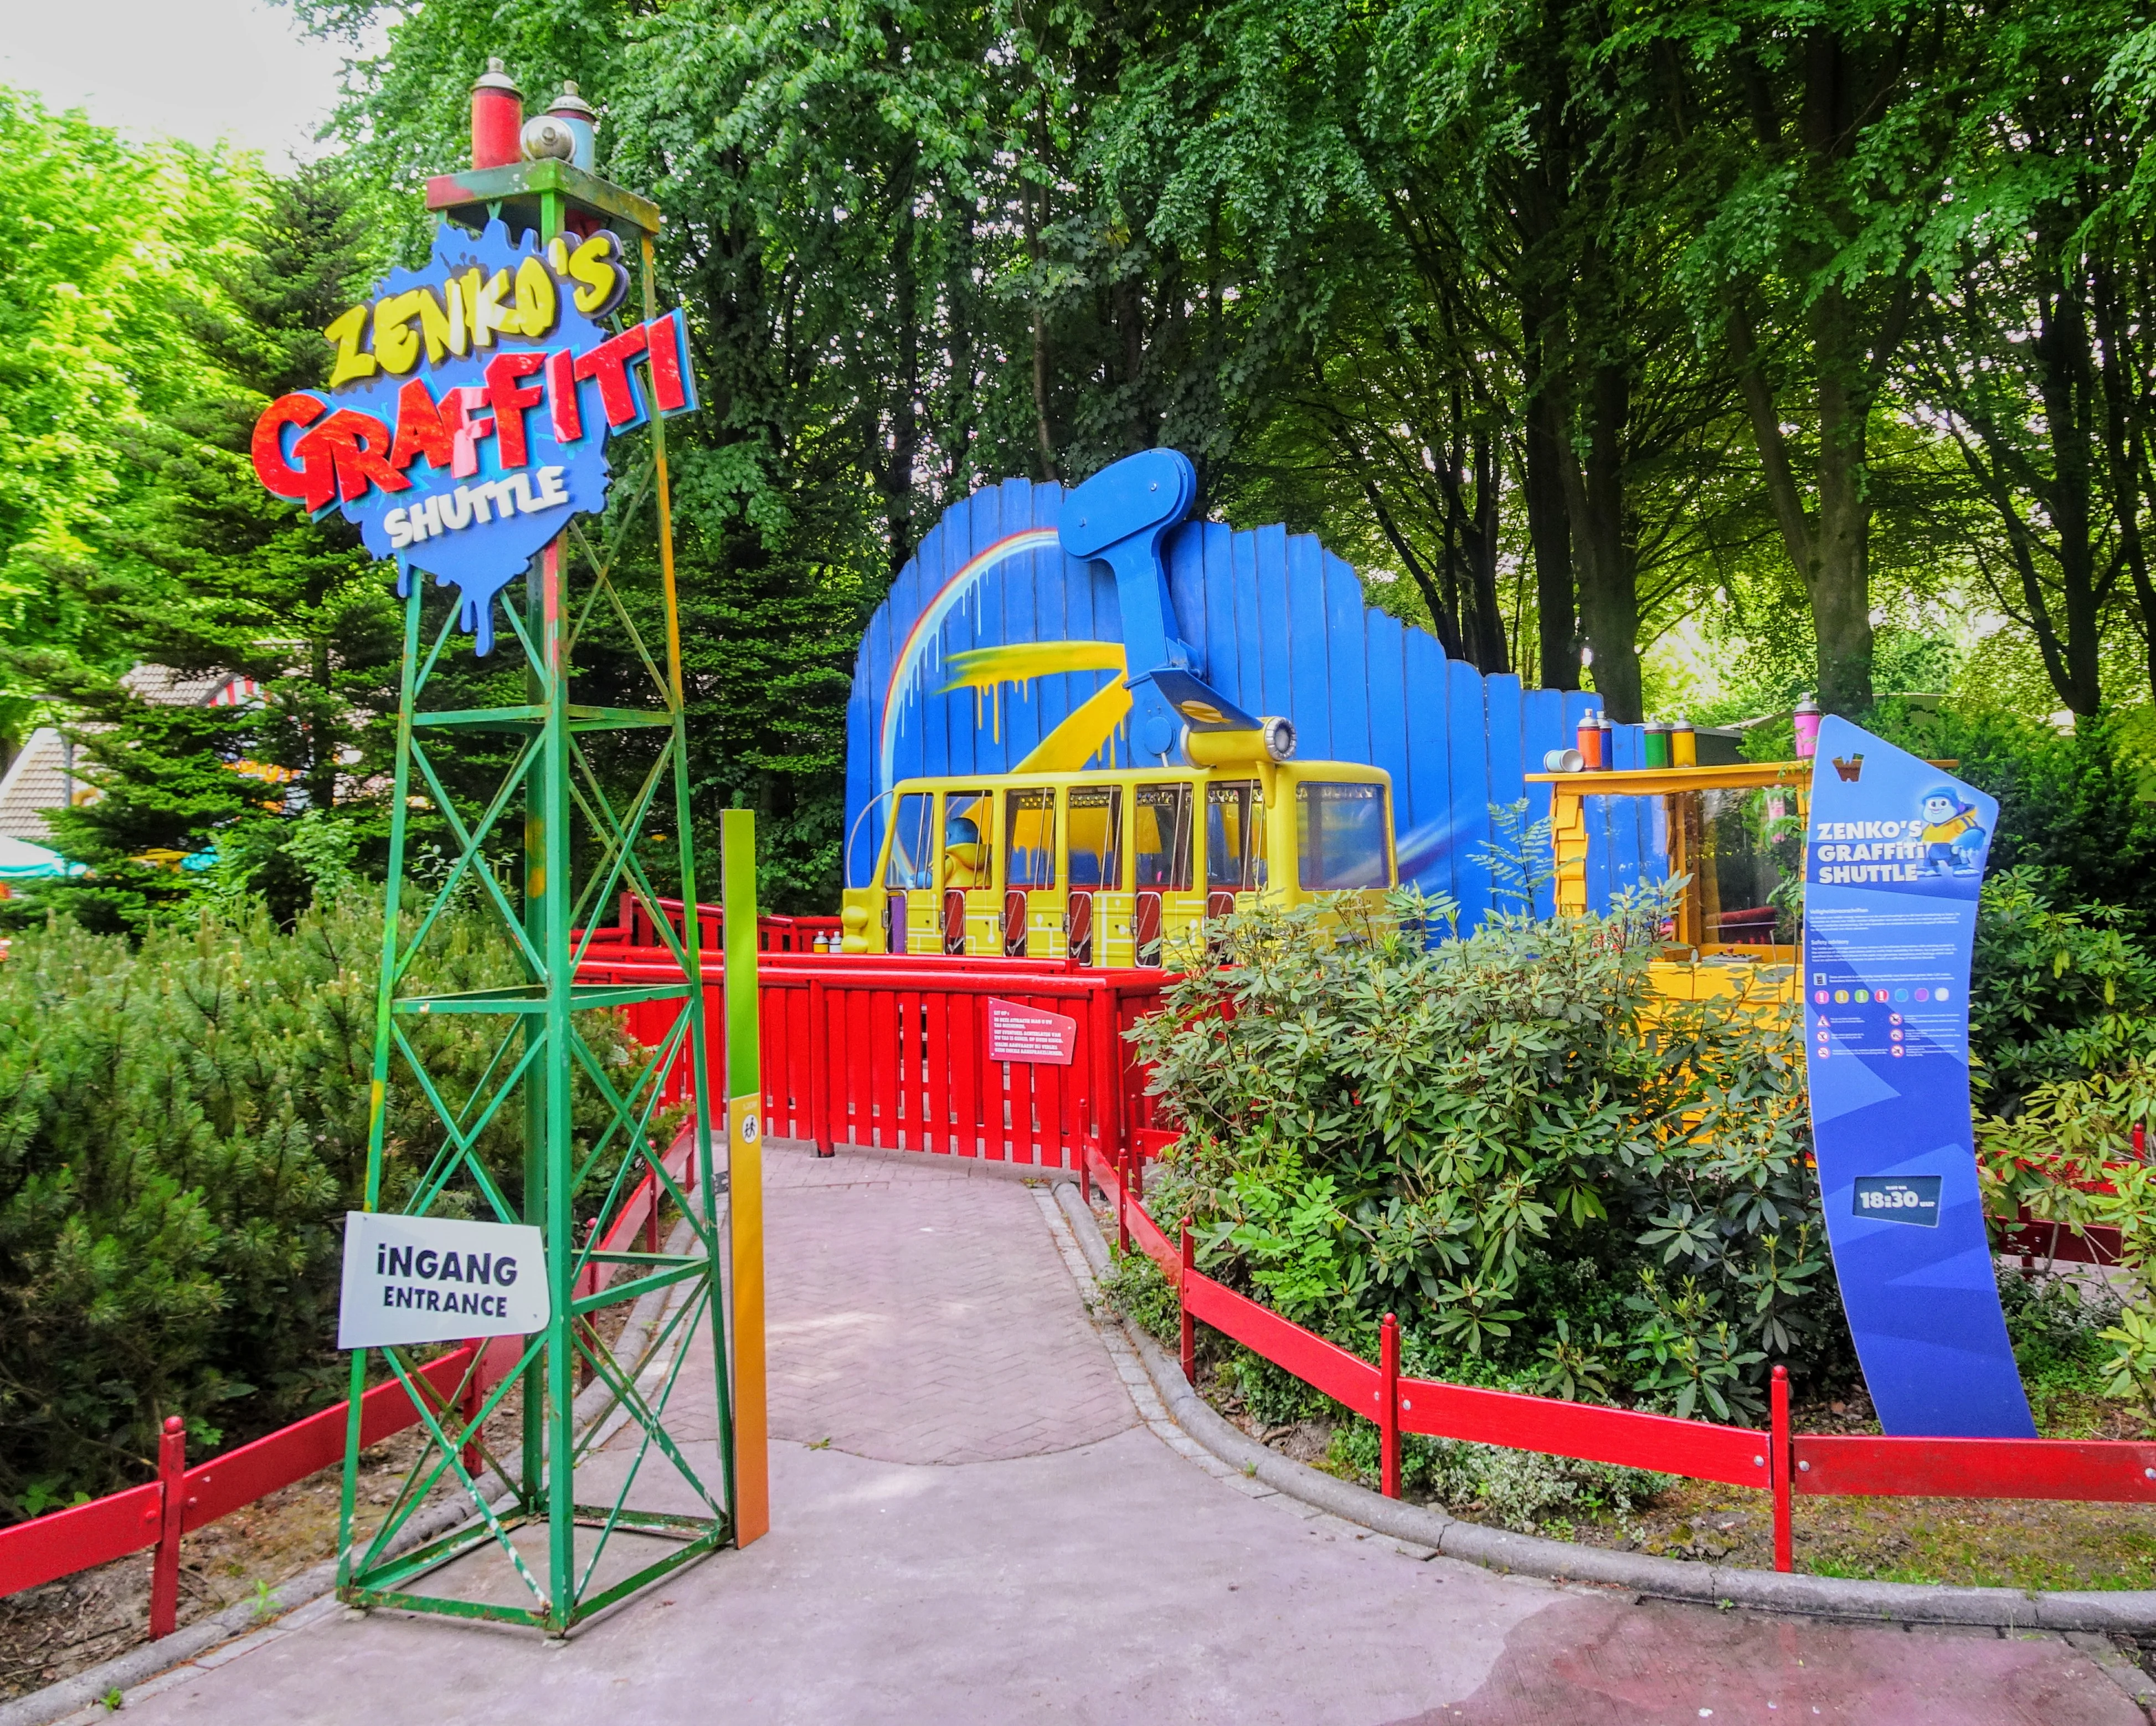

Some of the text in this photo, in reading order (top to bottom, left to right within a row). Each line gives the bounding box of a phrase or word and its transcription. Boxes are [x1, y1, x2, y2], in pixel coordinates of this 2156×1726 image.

[324, 233, 618, 389] ZENKO'S
[251, 311, 687, 514] GRAFFITI
[383, 465, 569, 549] SHUTTLE
[1817, 820, 1923, 841] ZENKO'S
[1818, 864, 1918, 884] SHUTTLE
[1860, 1191, 1918, 1209] 18:30
[383, 1286, 508, 1318] ENTRANCE
